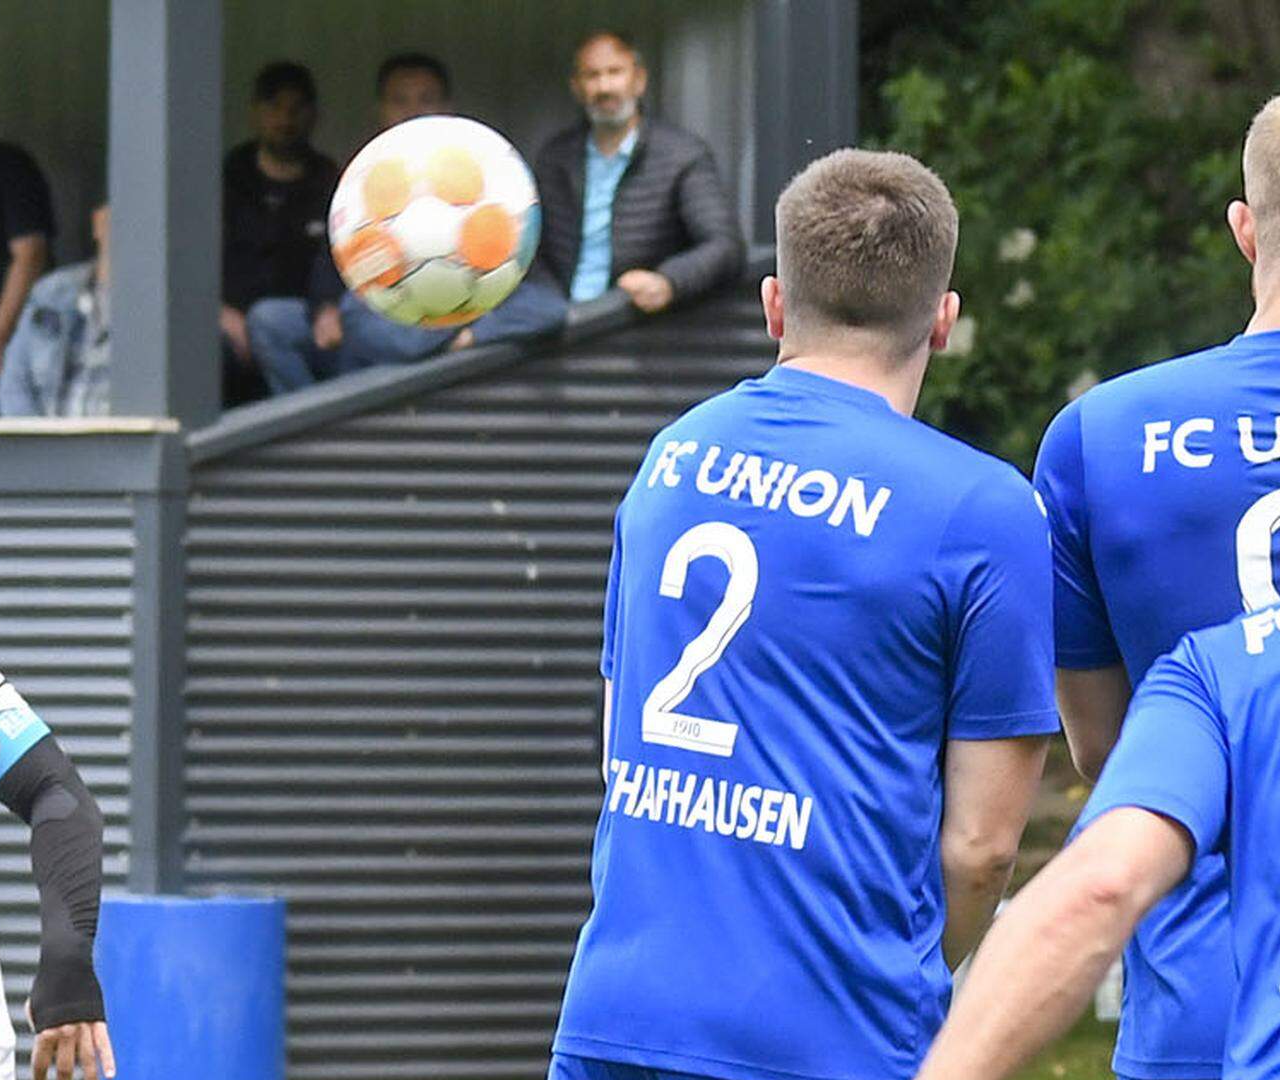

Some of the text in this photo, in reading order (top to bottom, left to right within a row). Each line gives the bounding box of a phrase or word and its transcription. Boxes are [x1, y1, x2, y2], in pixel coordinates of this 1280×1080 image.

[647, 440, 892, 537] FC UNION
[1142, 417, 1215, 473] FC
[641, 520, 760, 758] 2
